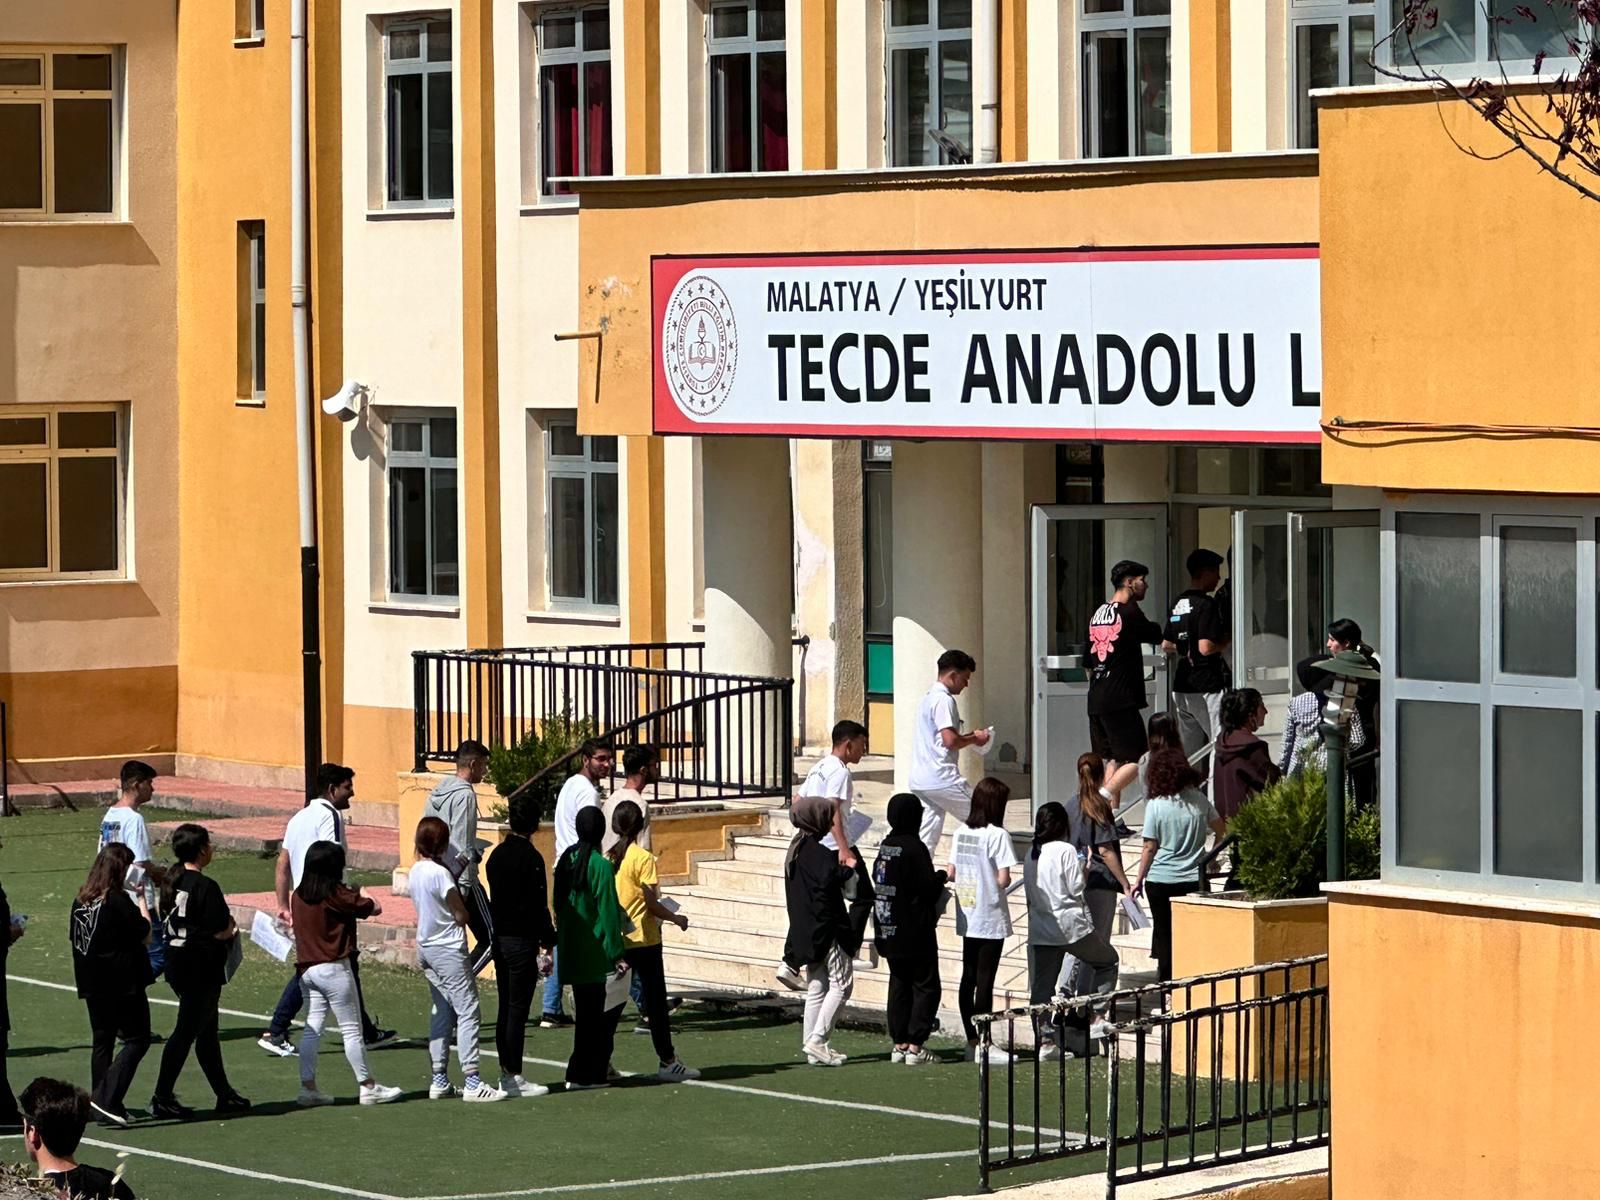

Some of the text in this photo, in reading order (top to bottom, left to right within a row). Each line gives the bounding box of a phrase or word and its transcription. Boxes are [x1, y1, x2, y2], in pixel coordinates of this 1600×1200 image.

[767, 268, 1047, 318] MALATYA / YEŞİLYURT
[767, 332, 931, 405] TECDE
[960, 332, 1256, 408] ANADOLU
